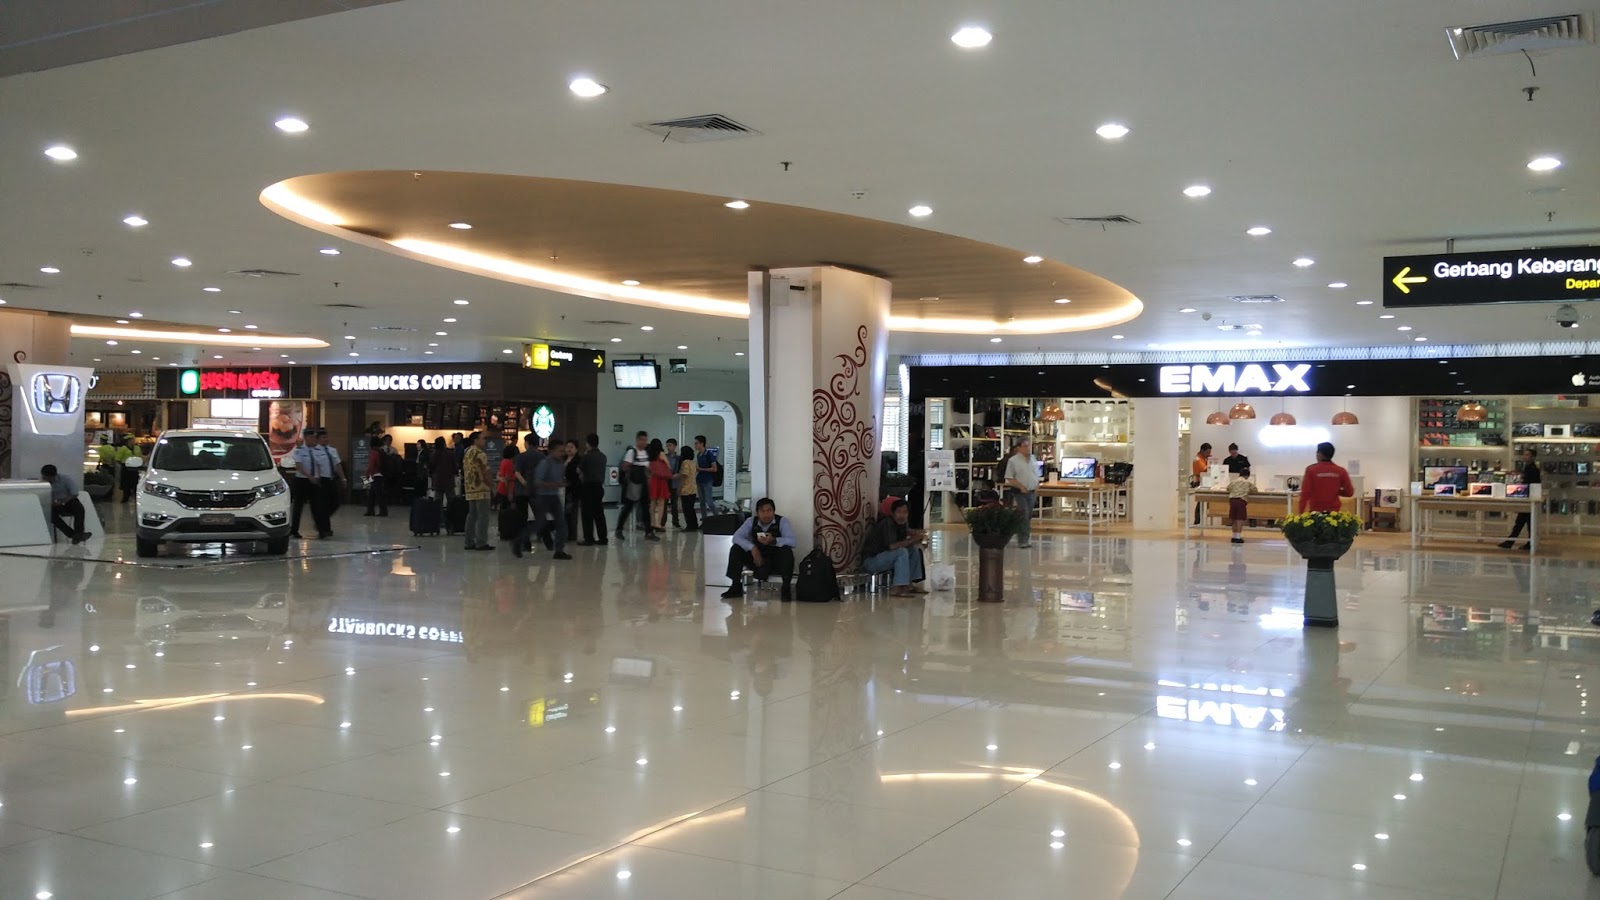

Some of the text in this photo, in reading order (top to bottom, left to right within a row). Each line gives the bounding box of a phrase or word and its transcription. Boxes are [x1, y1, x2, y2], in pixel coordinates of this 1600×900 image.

[1433, 261, 1513, 279] Gerbang
[331, 374, 482, 391] STARBUCKS COFFEE
[1160, 363, 1312, 393] EMAX
